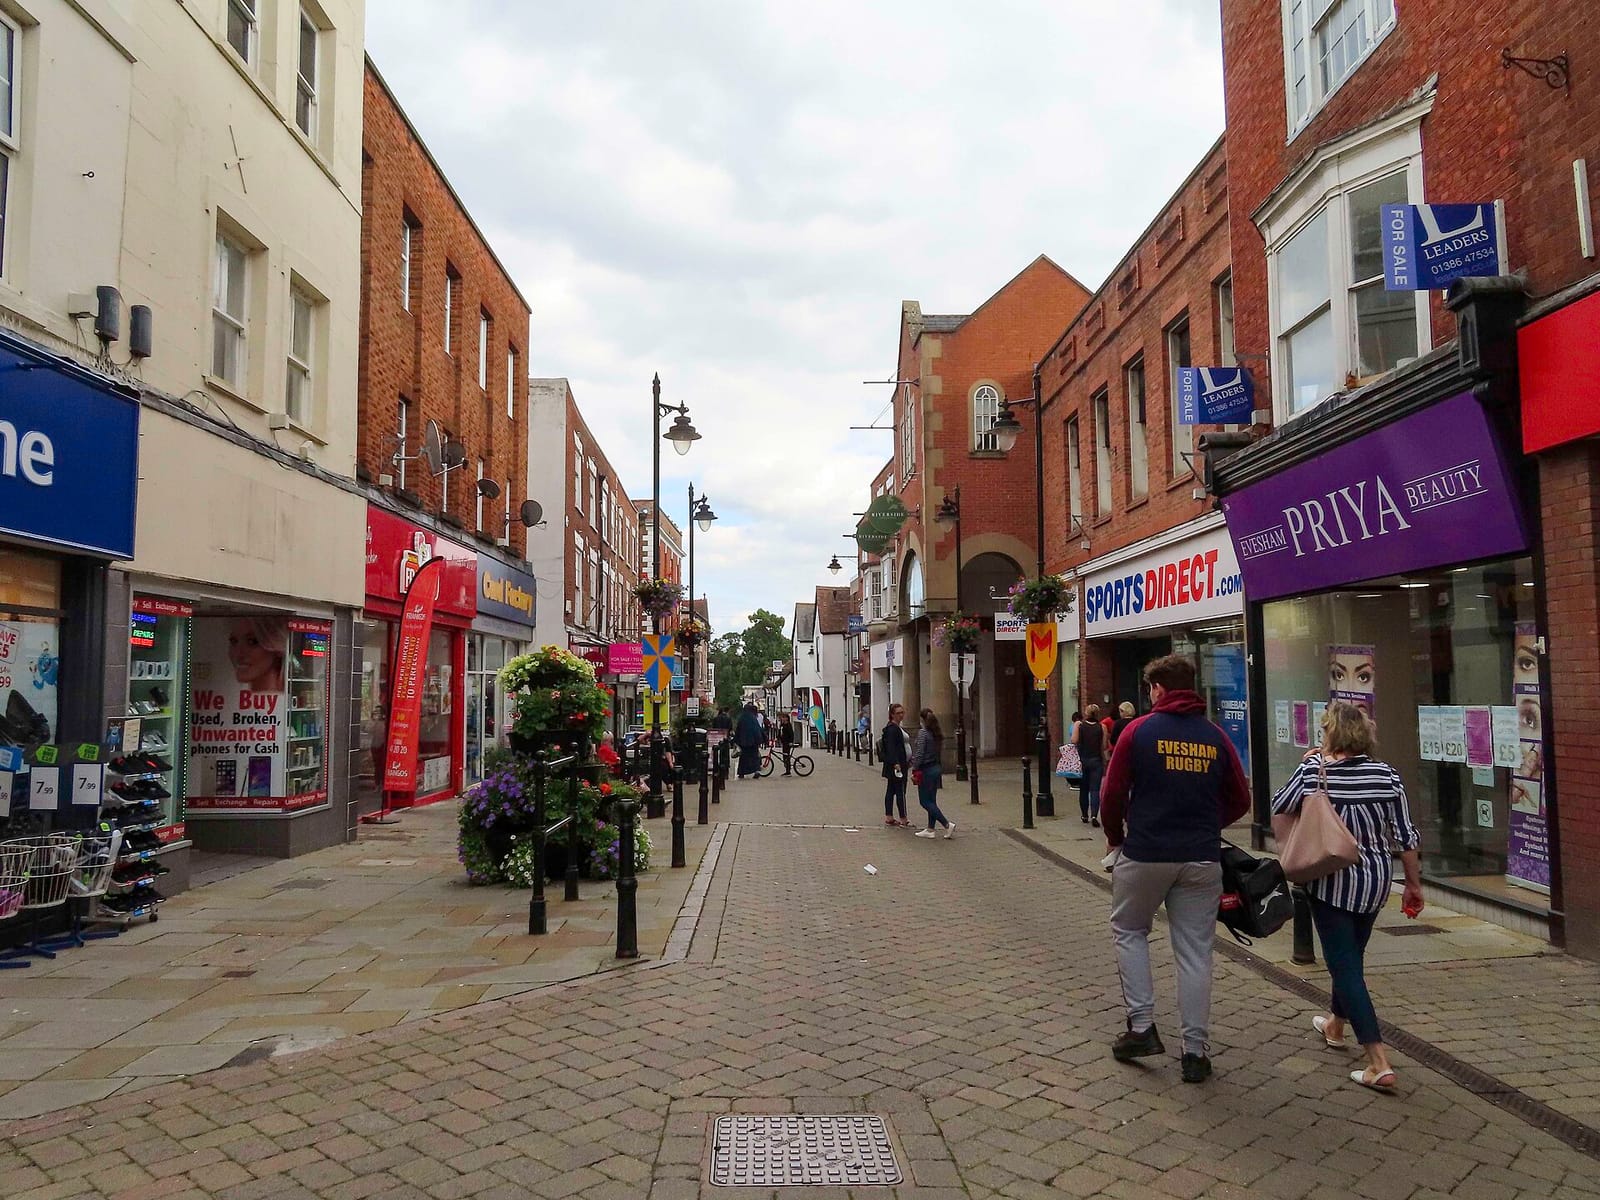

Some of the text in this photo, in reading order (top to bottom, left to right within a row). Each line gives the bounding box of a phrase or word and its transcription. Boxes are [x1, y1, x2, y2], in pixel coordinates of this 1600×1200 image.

[1391, 209, 1408, 286] FOR SALE
[1424, 230, 1489, 260] LEADERS
[1431, 246, 1495, 275] 01386 47534
[1183, 370, 1194, 421] FOR SALE
[1203, 385, 1245, 405] LEADERS
[1240, 465, 1483, 557] EVESHAM PRIYA BEAUTY
[194, 690, 278, 715] We Buy
[191, 712, 281, 727] Used, Broken,
[191, 725, 276, 742] Unwanted
[191, 743, 279, 757] phones for Cash
[1157, 740, 1217, 760] EVESHAM
[1445, 742, 1462, 756] £20
[1499, 744, 1515, 762] £5
[1166, 756, 1210, 773] RUGBY
[253, 798, 279, 807] Repairs
